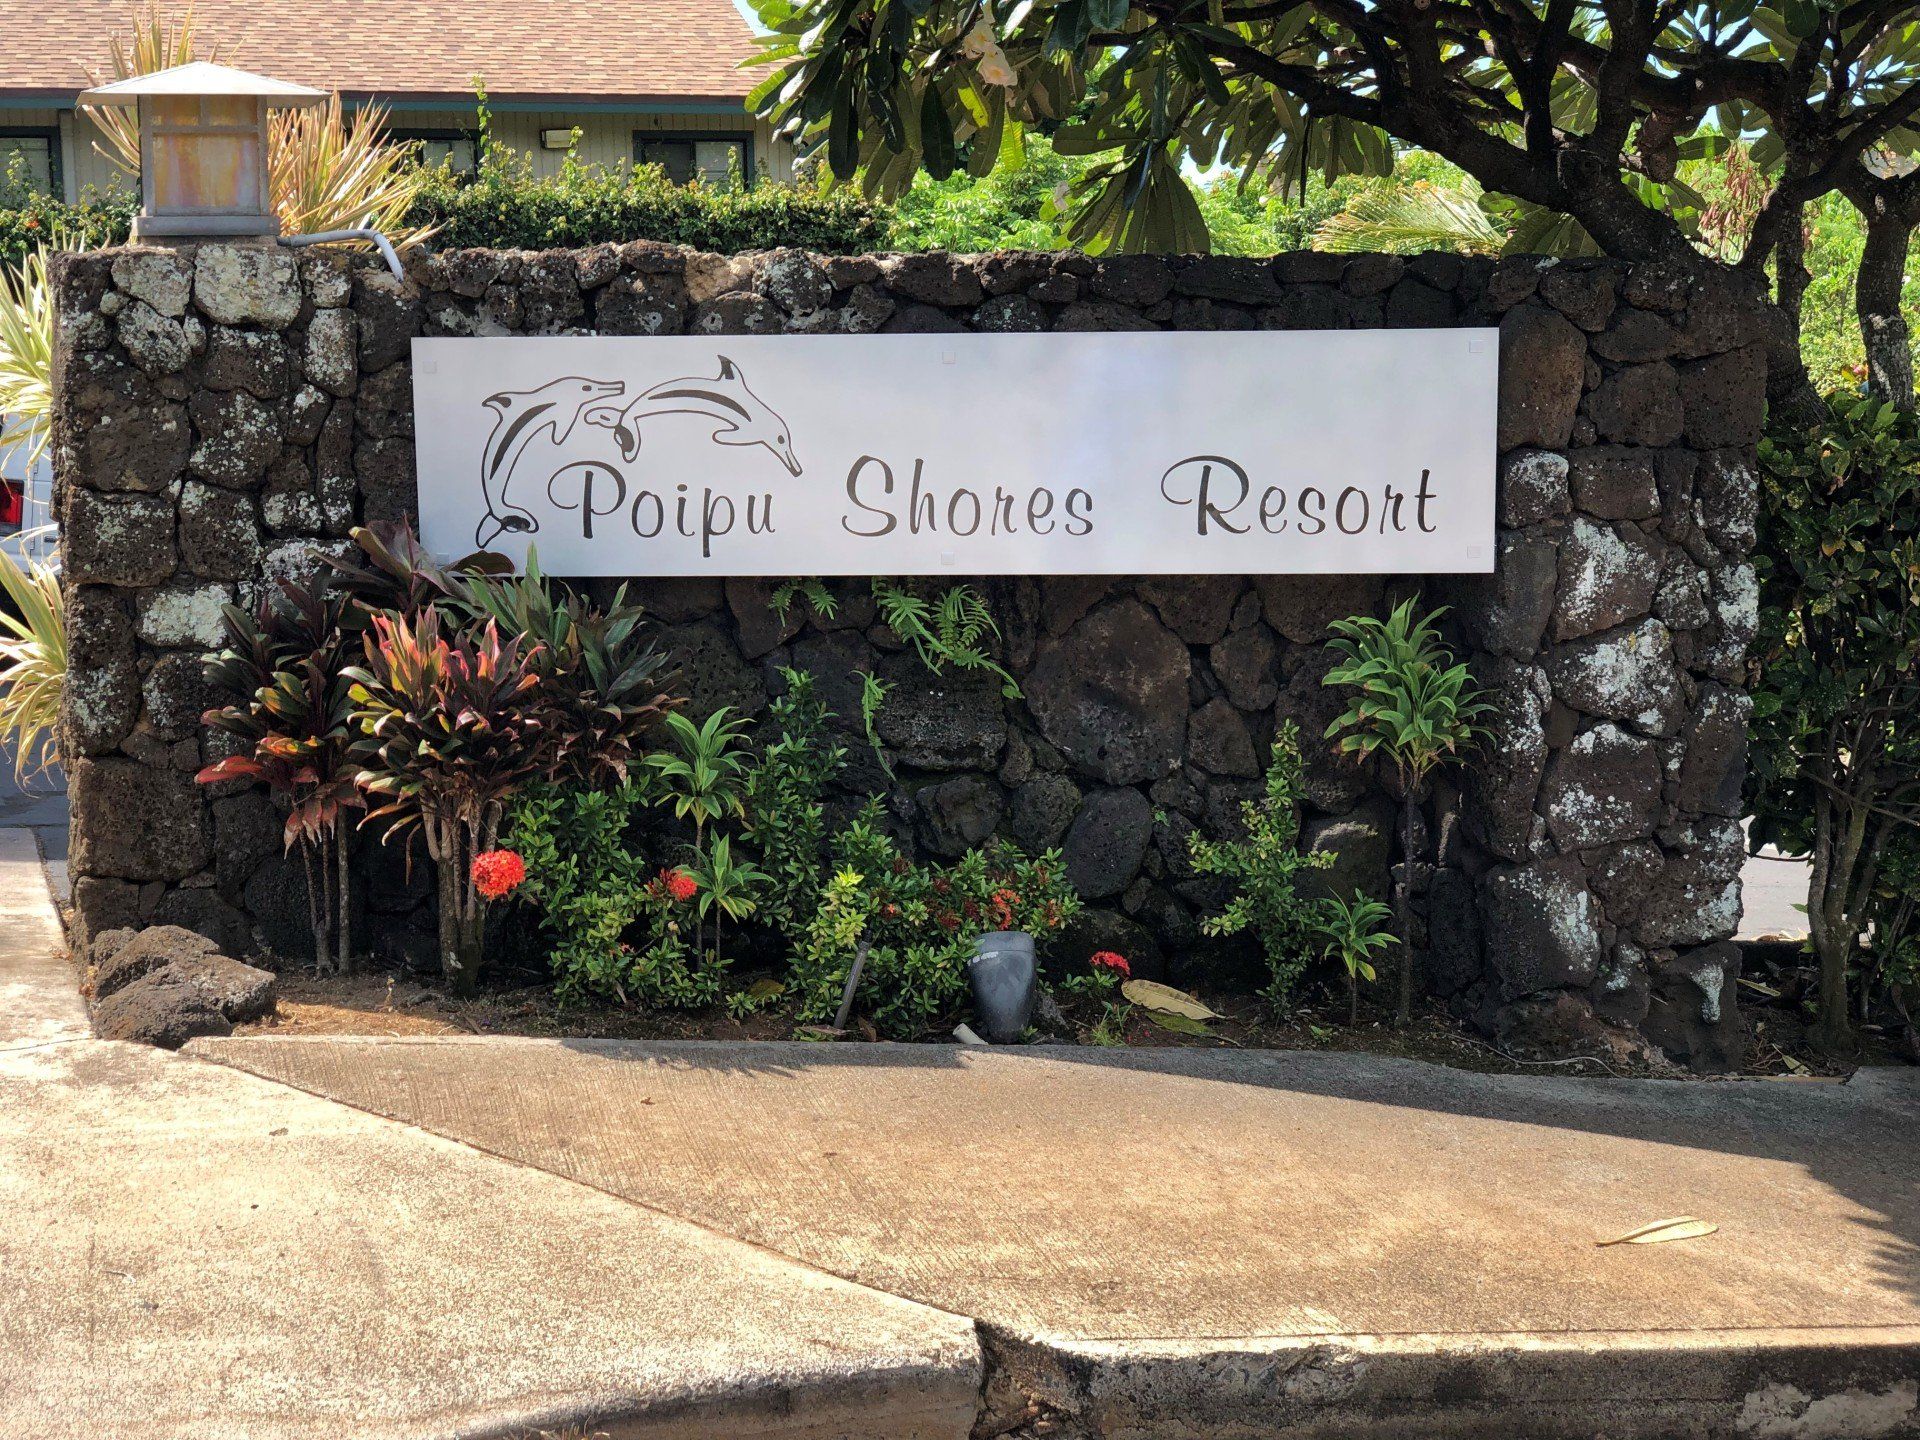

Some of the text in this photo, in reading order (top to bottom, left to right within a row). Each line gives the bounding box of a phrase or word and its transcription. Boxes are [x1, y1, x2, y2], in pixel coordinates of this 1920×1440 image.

[547, 455, 1437, 558] Poipu Shores Resort
